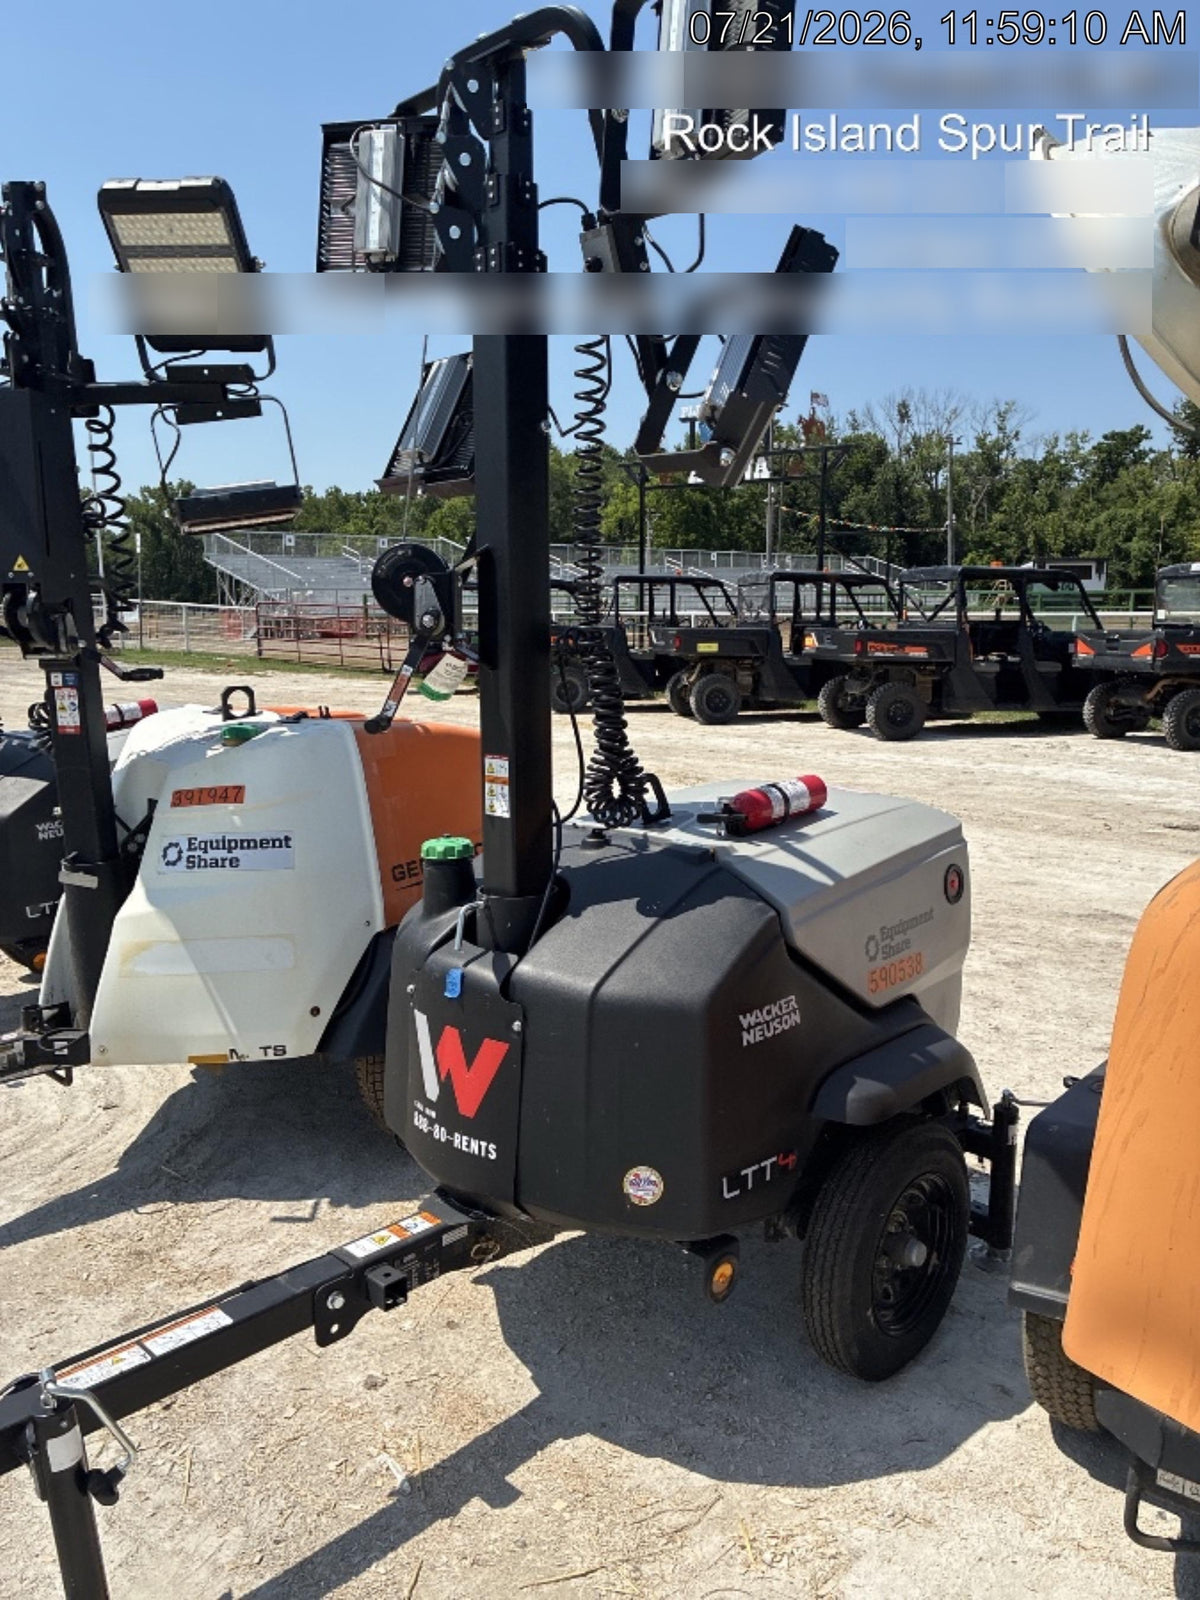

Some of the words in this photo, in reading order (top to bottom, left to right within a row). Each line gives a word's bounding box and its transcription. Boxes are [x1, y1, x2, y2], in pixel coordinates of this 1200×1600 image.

[171, 785, 243, 807] 391947
[38, 828, 64, 840] NEU
[186, 835, 292, 854] Equipment
[185, 854, 241, 869] Share
[391, 858, 423, 882] GE
[880, 906, 934, 942] Equipment
[881, 938, 912, 960] Share
[869, 952, 924, 993] 590538
[739, 995, 799, 1030] WACKER
[741, 1010, 801, 1047] NEUSON
[722, 1153, 797, 1199] LTT4
